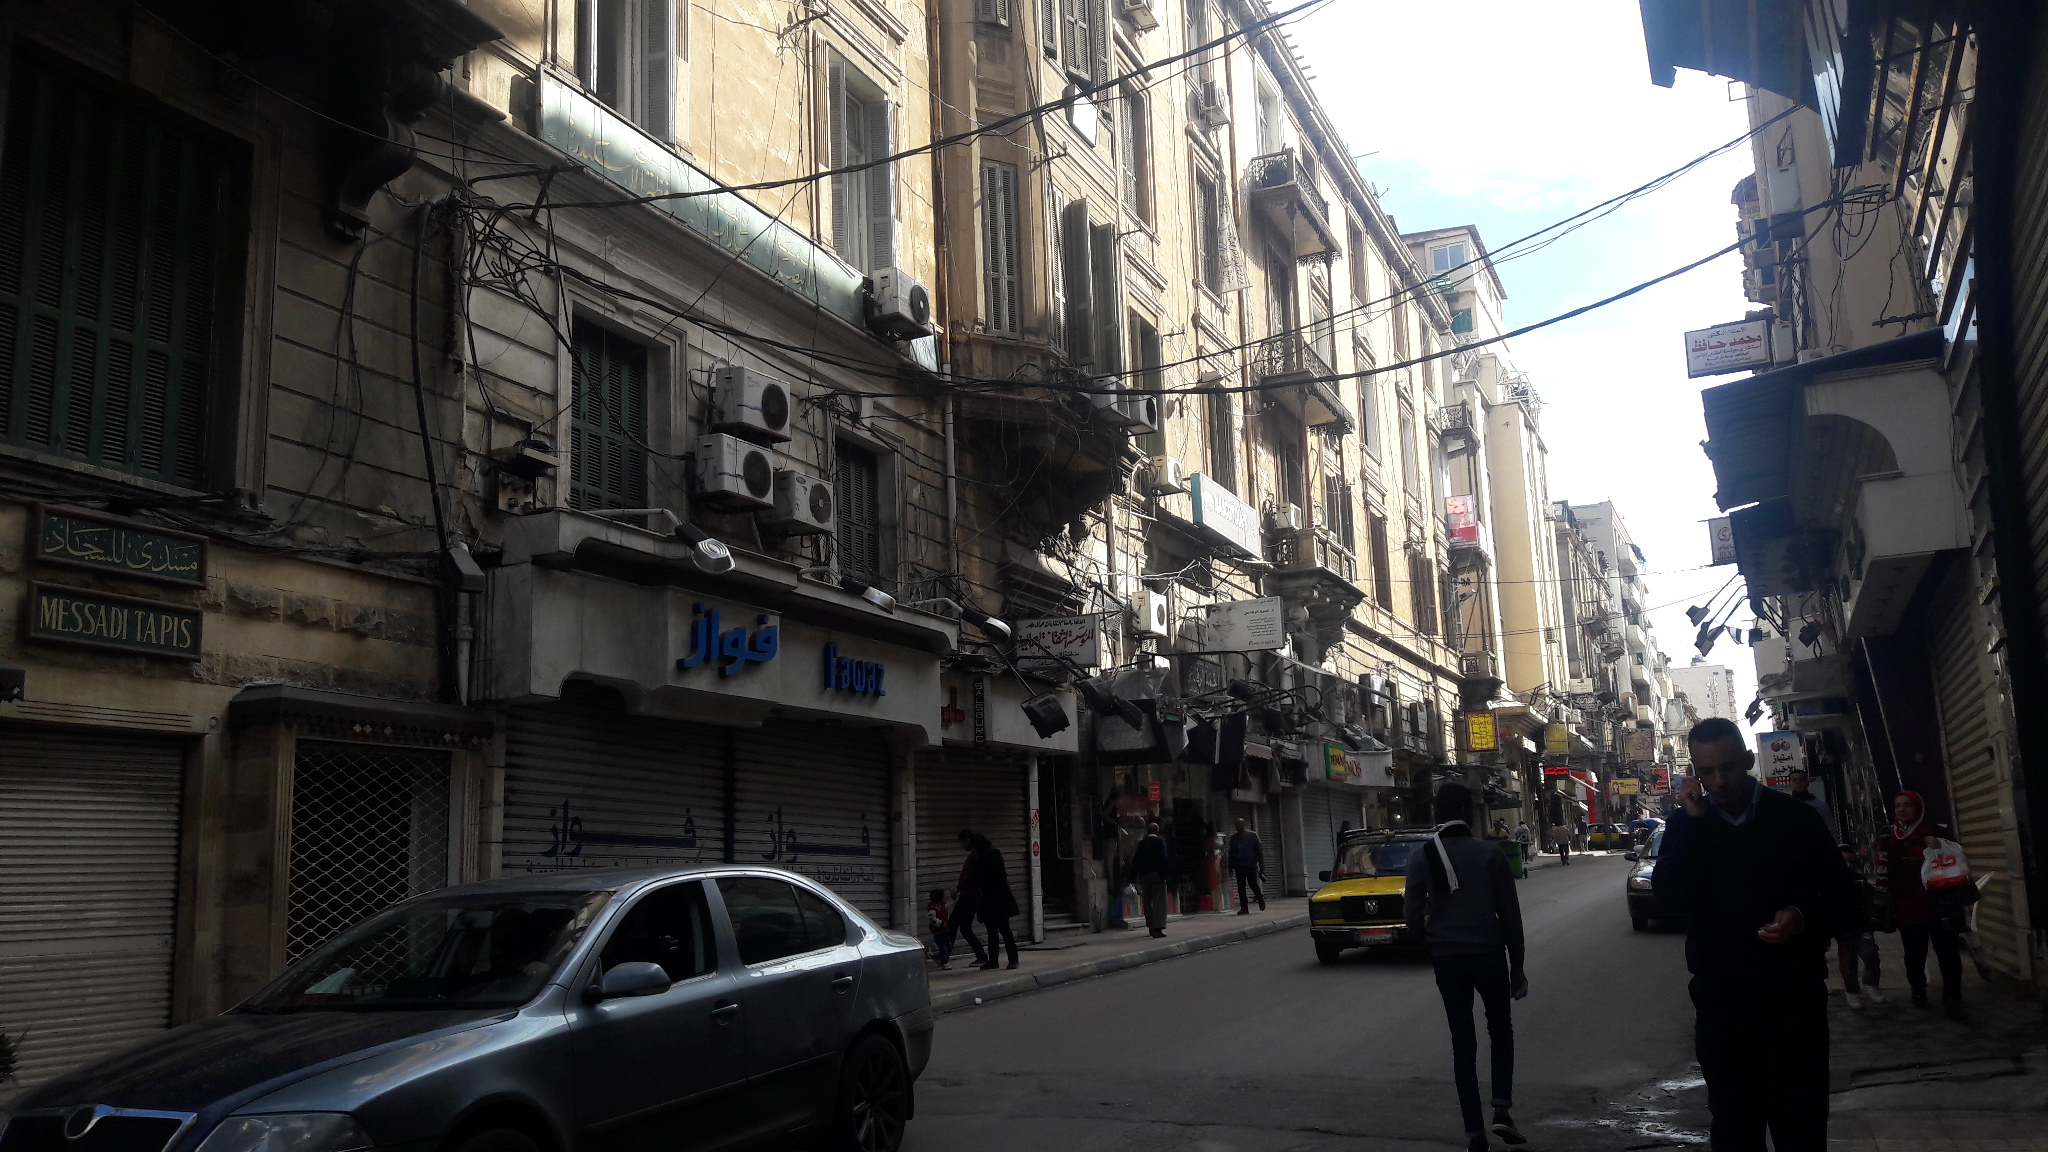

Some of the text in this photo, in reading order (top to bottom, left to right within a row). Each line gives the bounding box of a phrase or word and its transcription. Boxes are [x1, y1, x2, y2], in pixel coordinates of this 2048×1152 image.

[1691, 334, 1763, 353] محمد حافظ
[40, 596, 192, 649] MESSADI TAPIS
[678, 602, 778, 675] فواز
[542, 796, 697, 857] فواز
[762, 804, 872, 863] فواز
